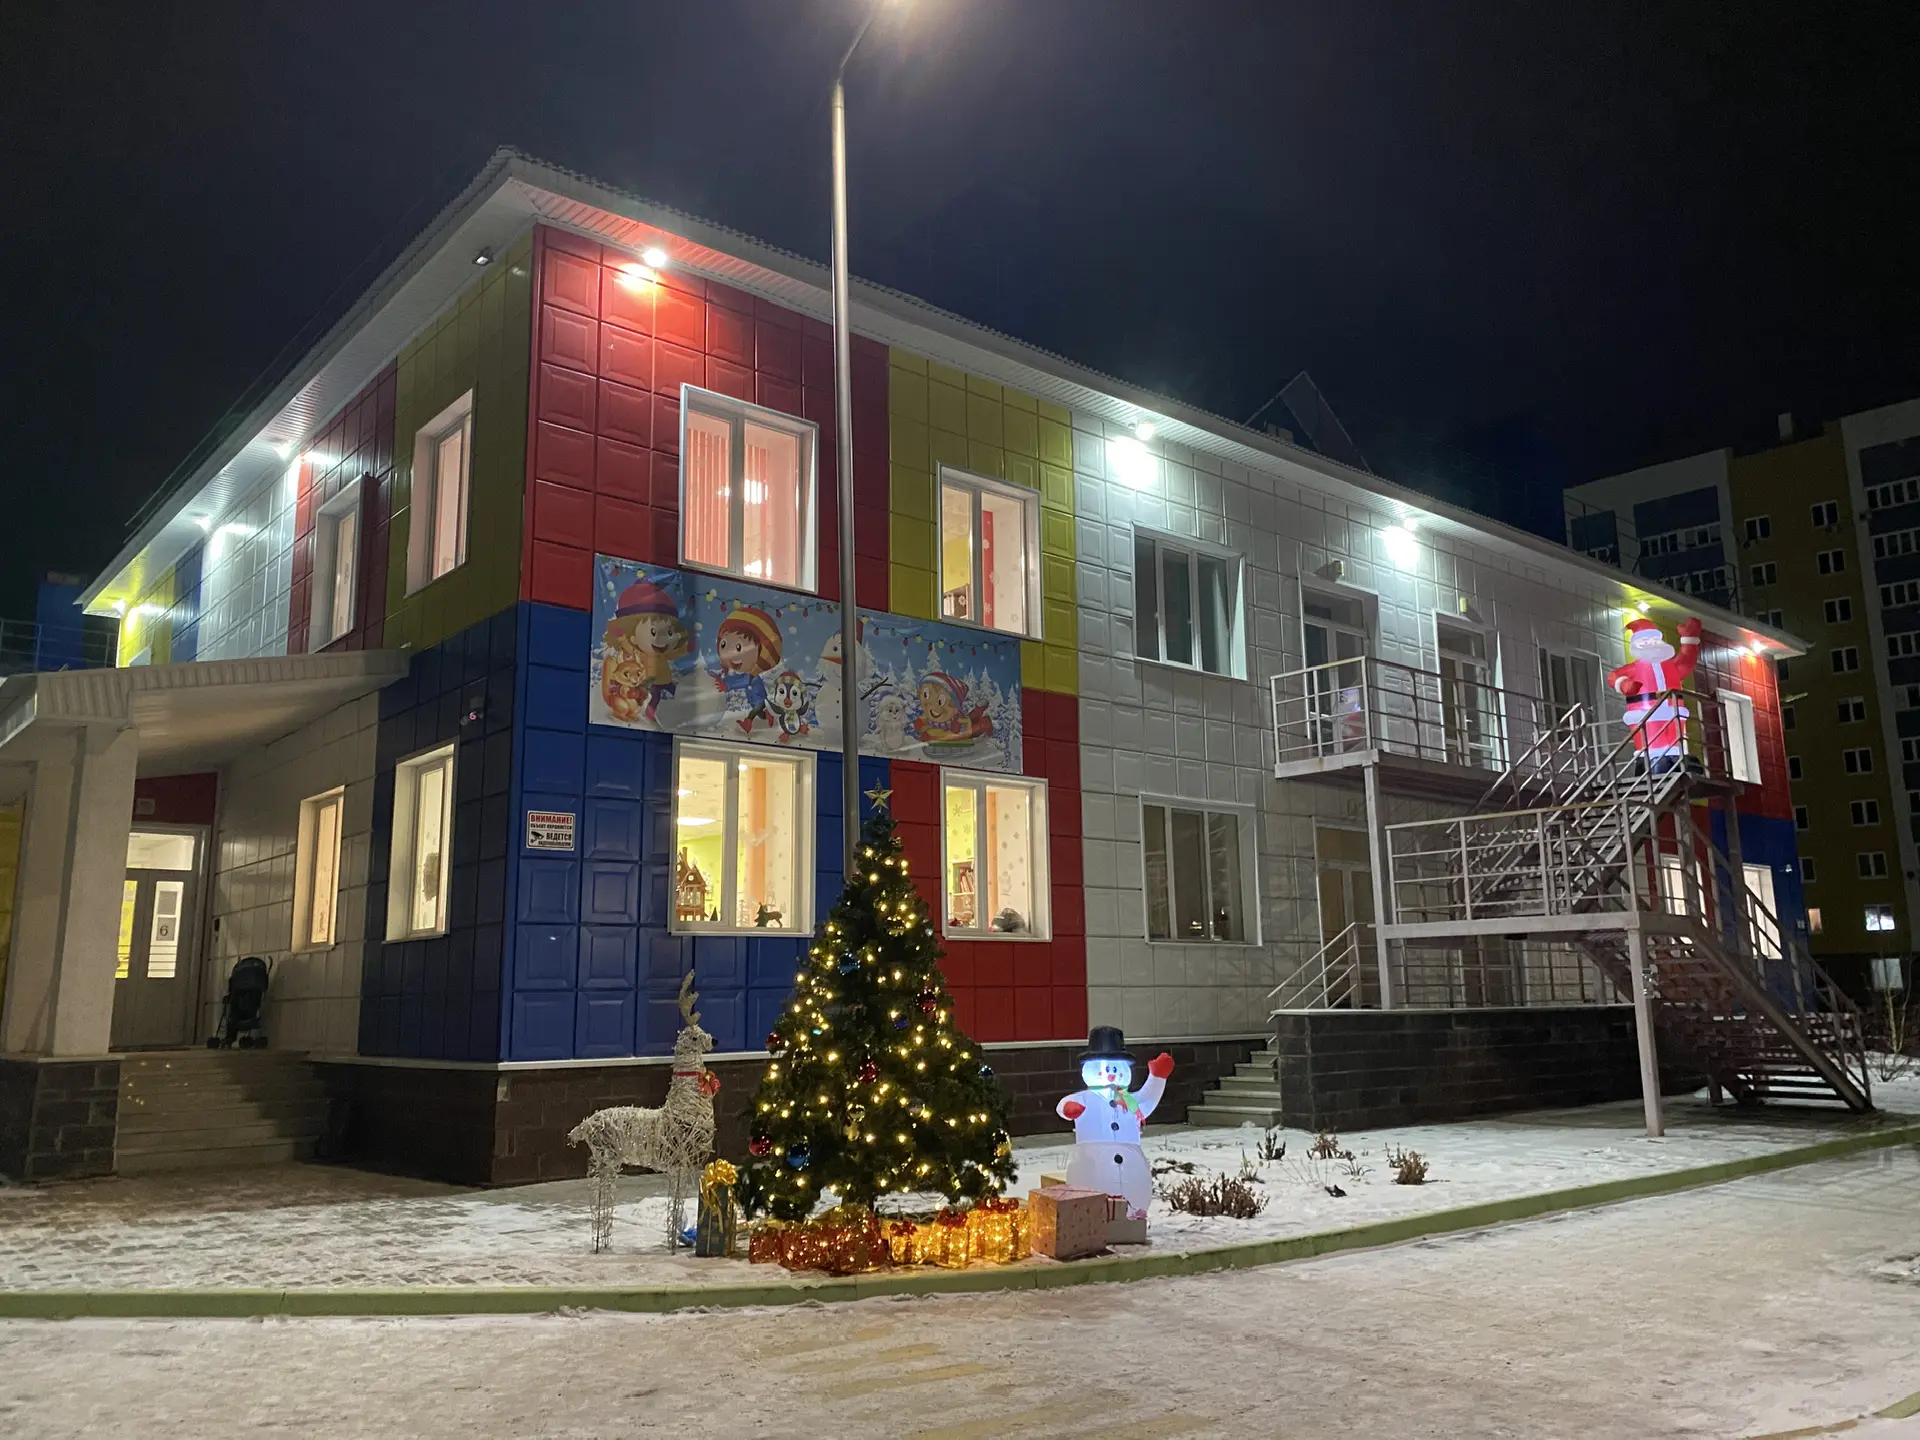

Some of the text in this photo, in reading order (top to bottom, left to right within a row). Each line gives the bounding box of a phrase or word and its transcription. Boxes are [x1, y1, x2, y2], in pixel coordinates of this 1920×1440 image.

[530, 814, 572, 824] ВНИМАНИЕ!
[546, 832, 572, 840] ВЕДЕТСЯ
[160, 925, 168, 936] 6
